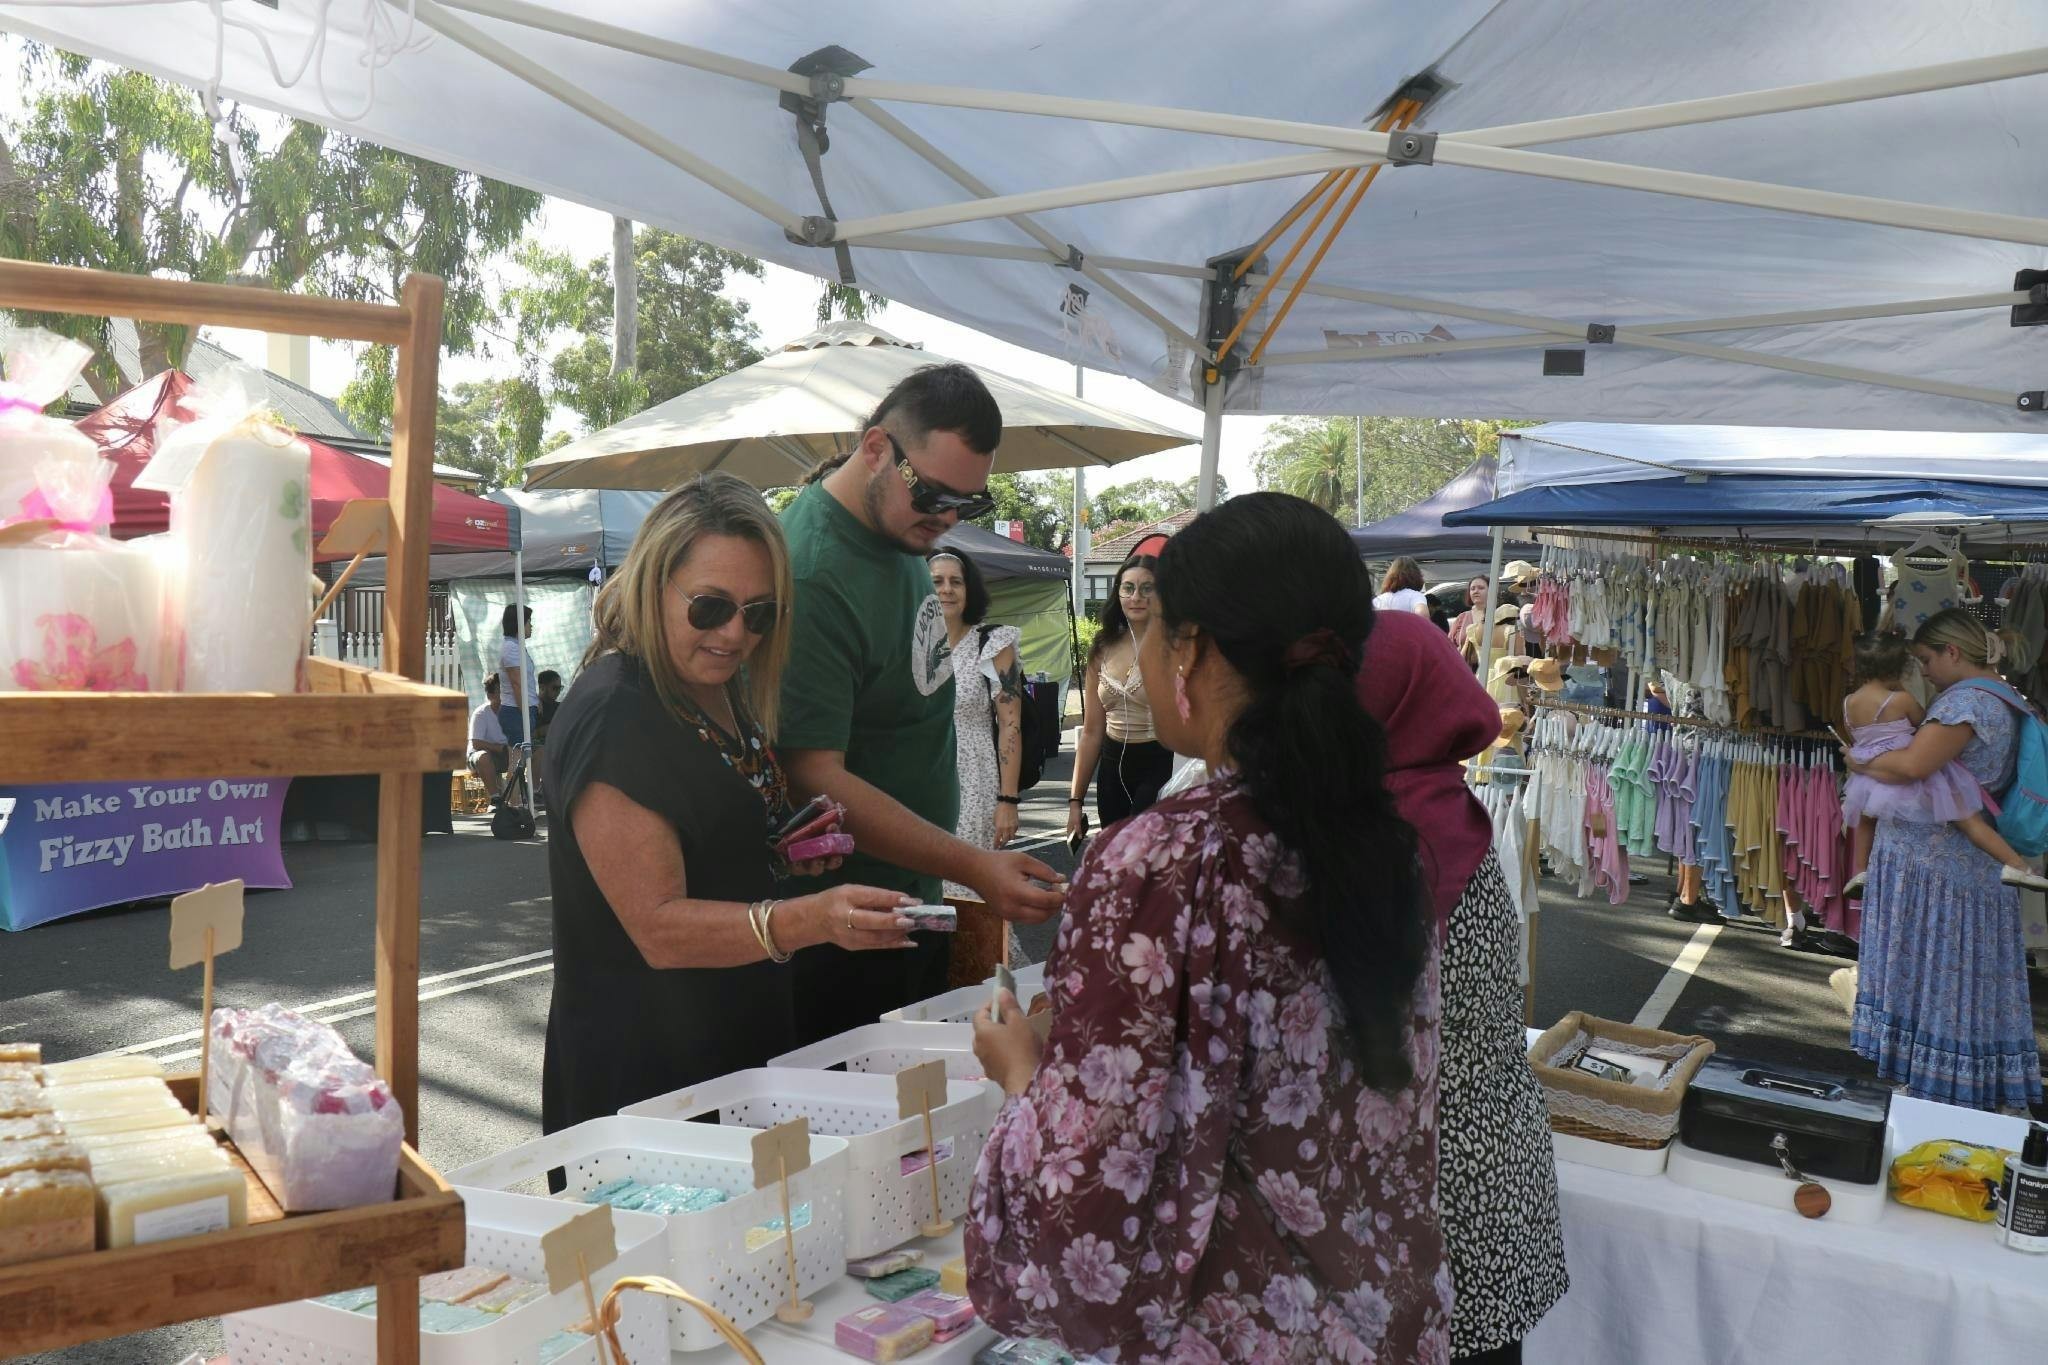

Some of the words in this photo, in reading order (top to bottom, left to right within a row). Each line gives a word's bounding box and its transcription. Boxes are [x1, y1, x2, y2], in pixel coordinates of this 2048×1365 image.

[33, 794, 121, 823] Make
[128, 785, 202, 809] Your
[208, 779, 269, 800] Own
[39, 835, 135, 872] Fizzy
[142, 818, 213, 853] Bath
[219, 816, 264, 845] Art
[2020, 1178, 2048, 1189] thankyo
